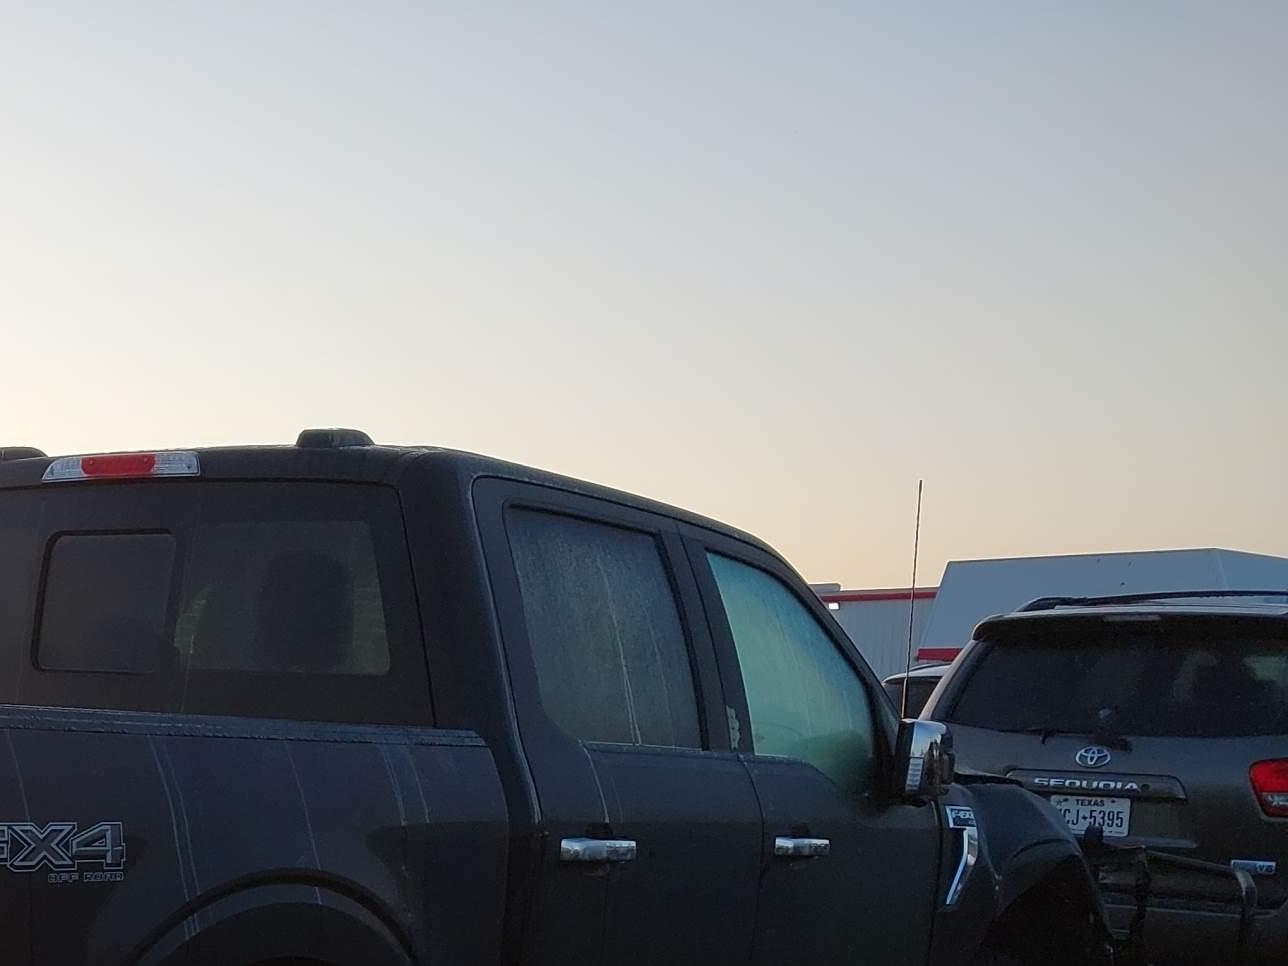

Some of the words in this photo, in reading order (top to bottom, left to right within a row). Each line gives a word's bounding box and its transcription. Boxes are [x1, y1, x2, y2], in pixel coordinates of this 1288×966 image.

[1033, 777, 1141, 792] SEQUOIA
[1075, 799, 1105, 807] TEXAS
[47, 872, 80, 884] OFF
